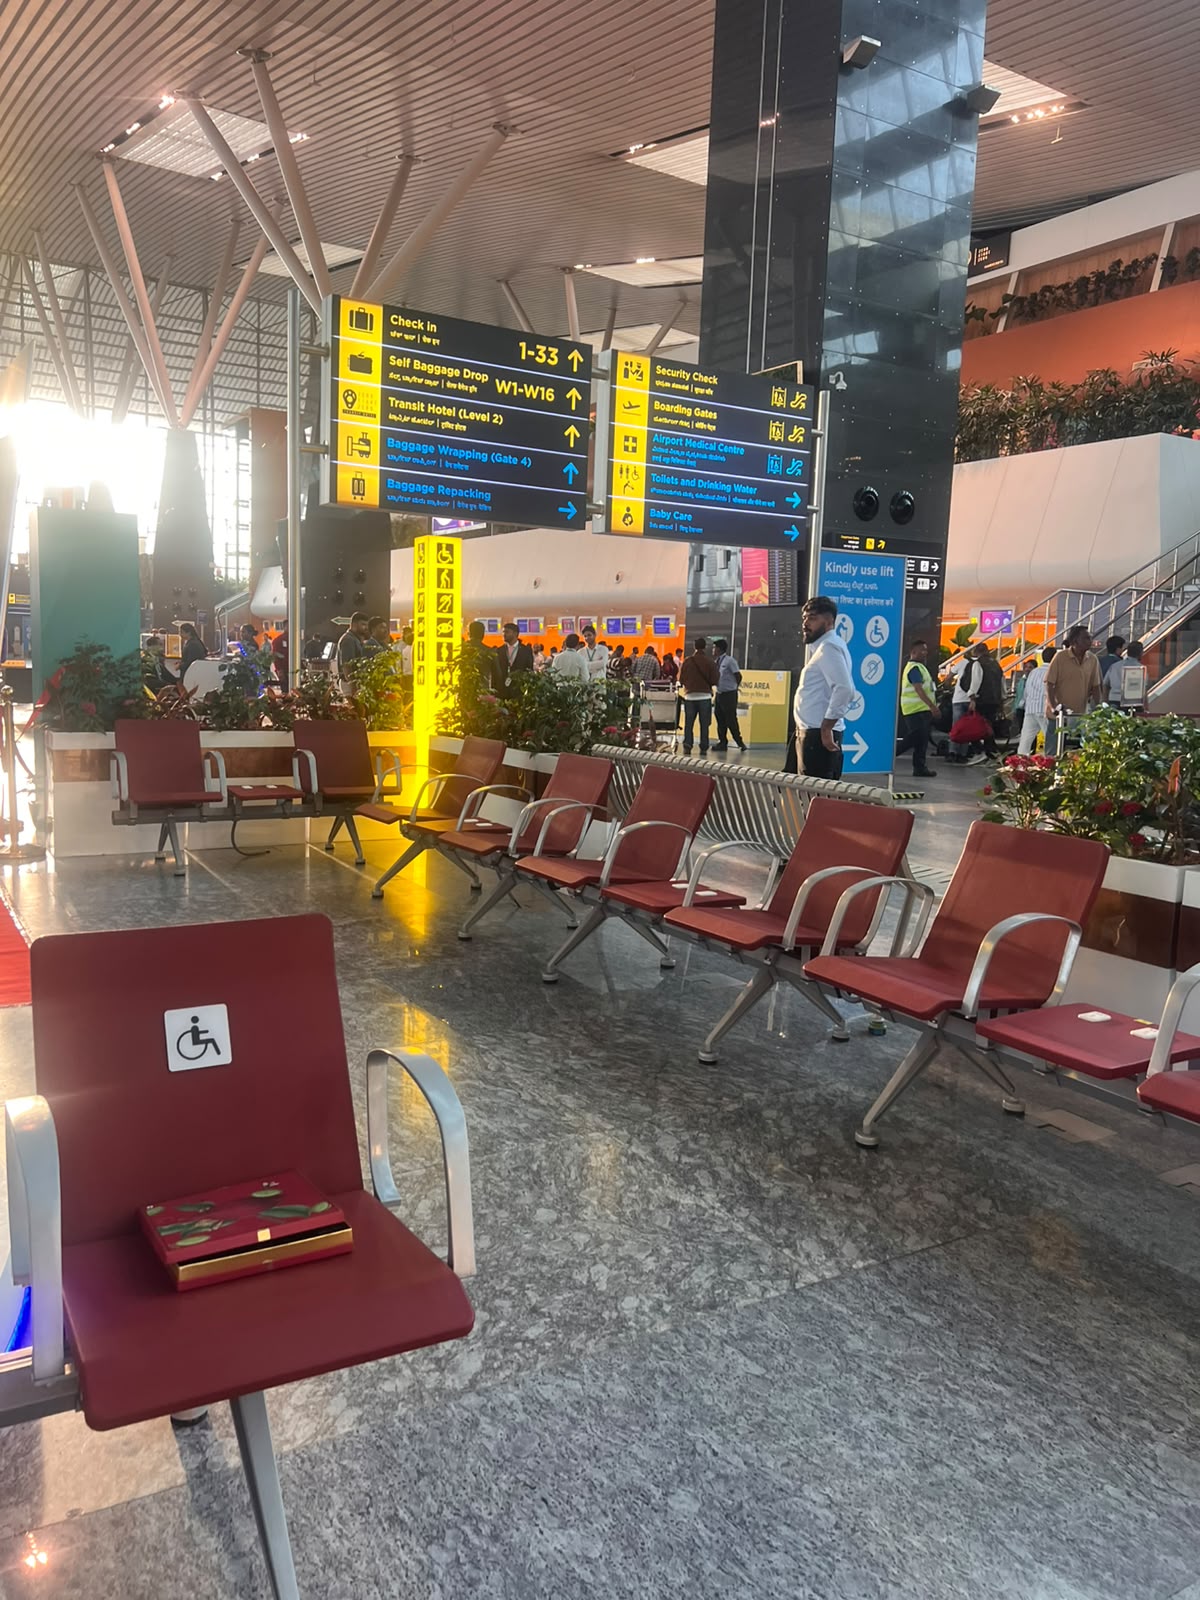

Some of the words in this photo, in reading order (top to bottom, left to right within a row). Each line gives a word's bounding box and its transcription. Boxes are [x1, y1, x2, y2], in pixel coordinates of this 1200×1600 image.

[390, 314, 424, 330] Check
[427, 321, 437, 333] in
[519, 341, 559, 366] 1-33
[389, 355, 411, 368] Self
[413, 359, 460, 377] Baggage
[463, 368, 489, 383] Drop
[655, 365, 691, 381] Security
[692, 372, 718, 385] Check
[495, 378, 555, 402] W1-W16
[388, 396, 425, 412] Transit
[427, 403, 456, 417] Hotel
[458, 408, 490, 422] (Level
[492, 413, 504, 425] 2)
[654, 400, 692, 417] Boarding
[694, 407, 718, 420] Gates
[387, 437, 435, 454] Baggage
[437, 444, 488, 462] Wrapping
[490, 453, 518, 465] (Gate
[520, 456, 532, 468] 4)
[652, 433, 683, 446] Airport
[685, 438, 716, 452] Medical
[717, 443, 745, 456] Centre
[387, 478, 435, 495] Baggage
[437, 485, 492, 502] Repacking
[650, 473, 679, 486] Toilets
[680, 478, 697, 488] and
[697, 480, 732, 493] Drinking
[733, 483, 758, 495] Water
[649, 508, 672, 521] Baby
[673, 511, 693, 522] Care
[825, 561, 858, 577] Kindly
[860, 566, 878, 576] use
[880, 565, 895, 578] lift
[754, 682, 770, 690] AREA
